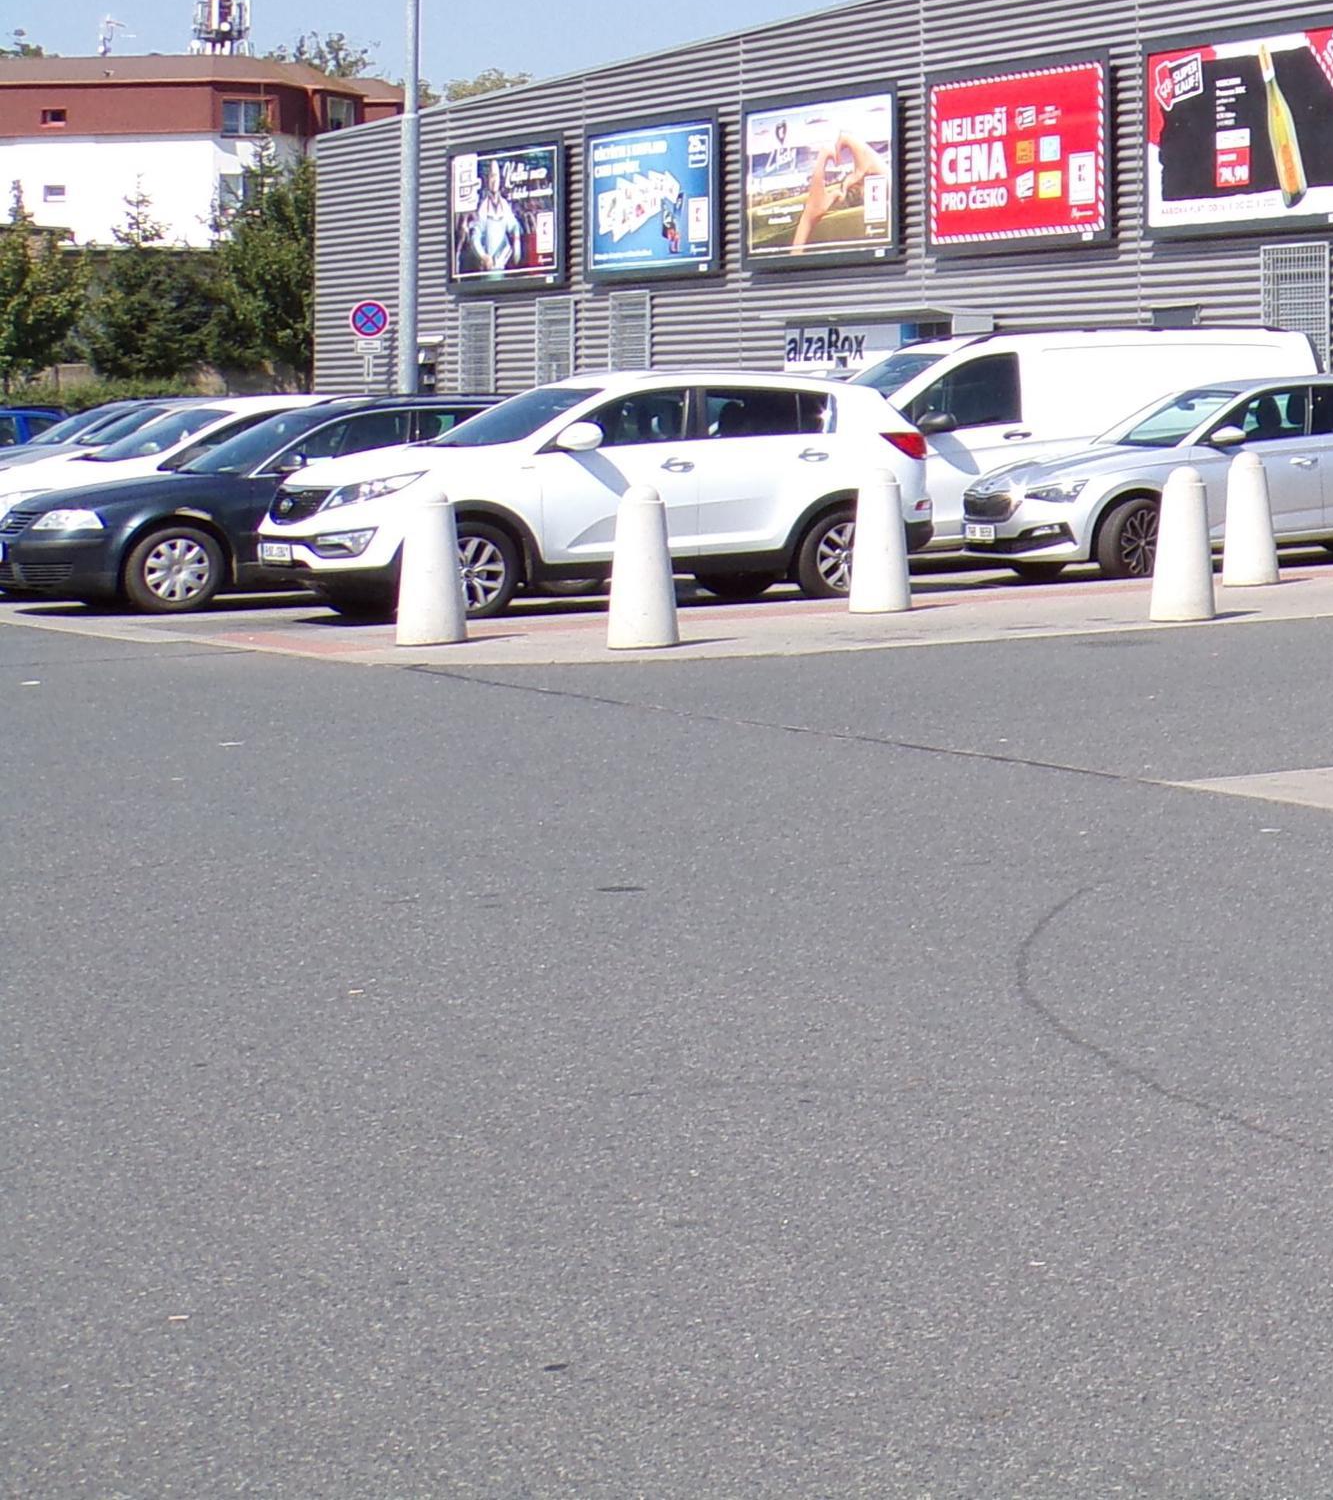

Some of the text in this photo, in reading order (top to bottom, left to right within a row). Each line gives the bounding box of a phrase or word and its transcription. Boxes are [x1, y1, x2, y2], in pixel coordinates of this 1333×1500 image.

[1173, 61, 1198, 82] SUPER
[1174, 72, 1199, 96] KAUF!
[941, 106, 1007, 144] NEJLEPŠÍ
[941, 141, 1007, 185] CENA
[941, 186, 1008, 211] PRO ČESKO
[787, 327, 865, 362] alzaBox
